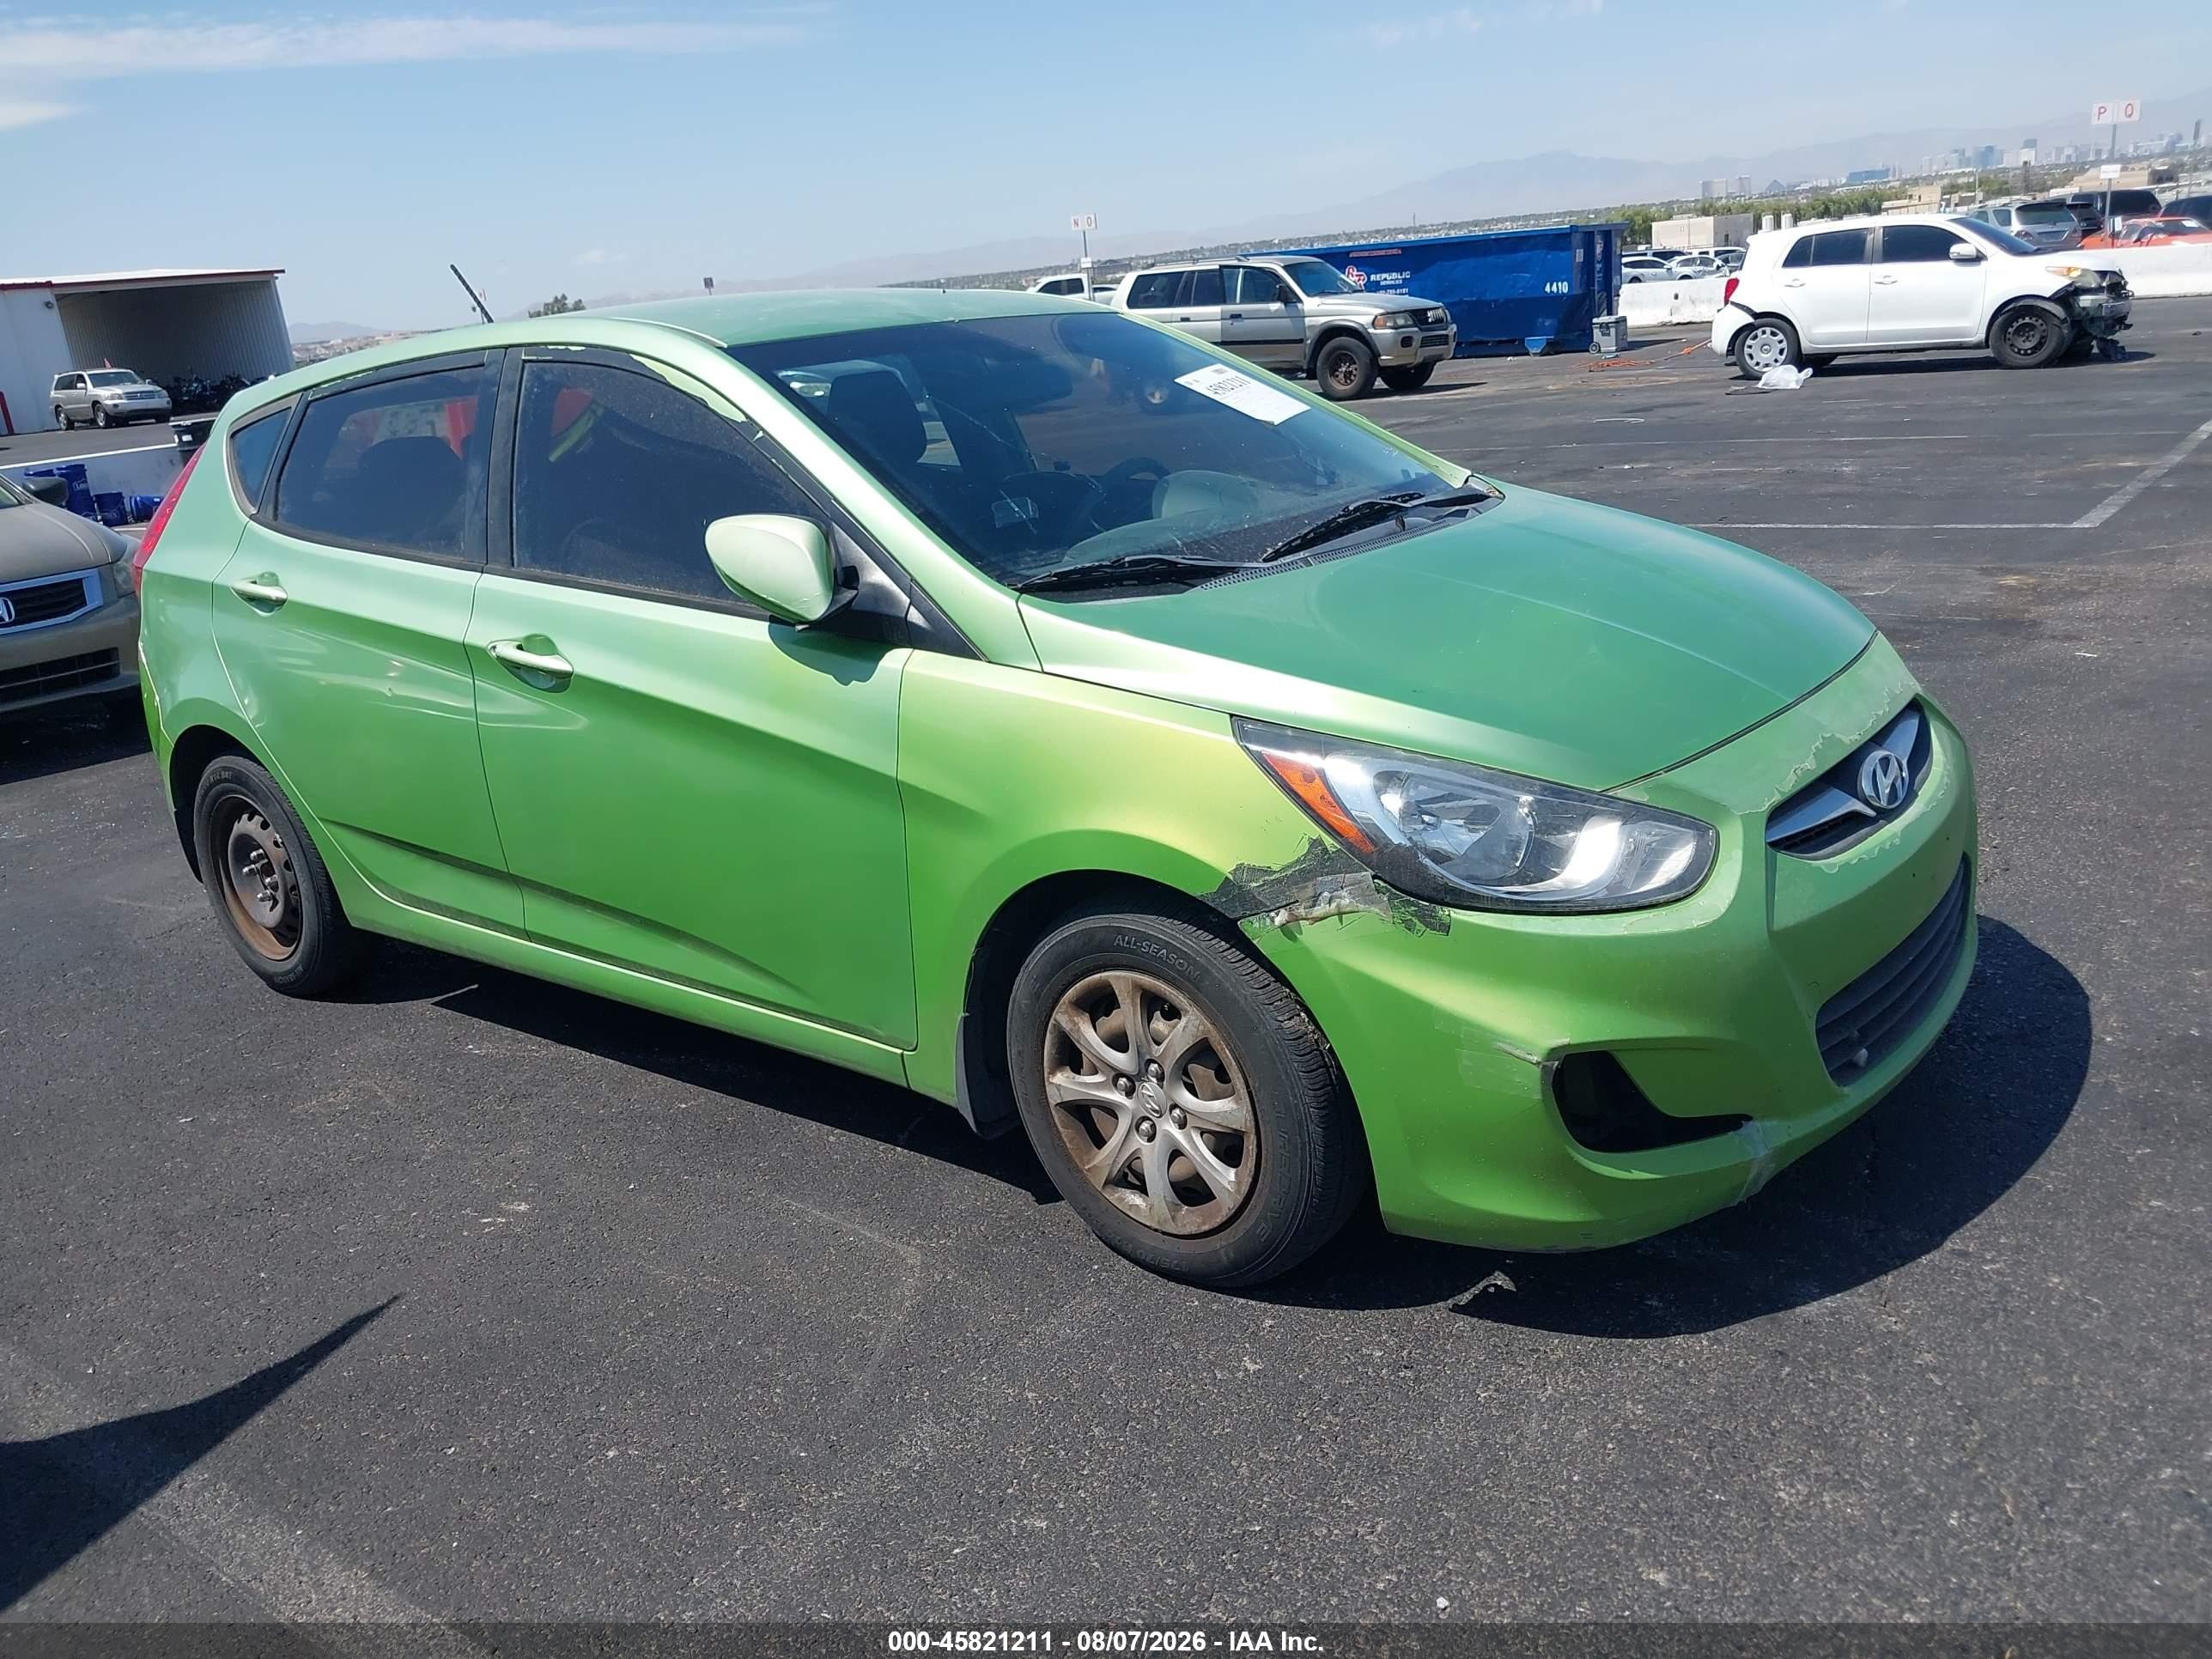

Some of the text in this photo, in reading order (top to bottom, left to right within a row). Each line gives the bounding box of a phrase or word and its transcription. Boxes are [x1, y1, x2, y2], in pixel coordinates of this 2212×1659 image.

[2097, 106, 2107, 121] P
[1073, 218, 1079, 228] N
[1370, 270, 1411, 282] REPUBLIC
[1545, 281, 1569, 294] 4410
[1114, 934, 1200, 981] ALL-SEASON
